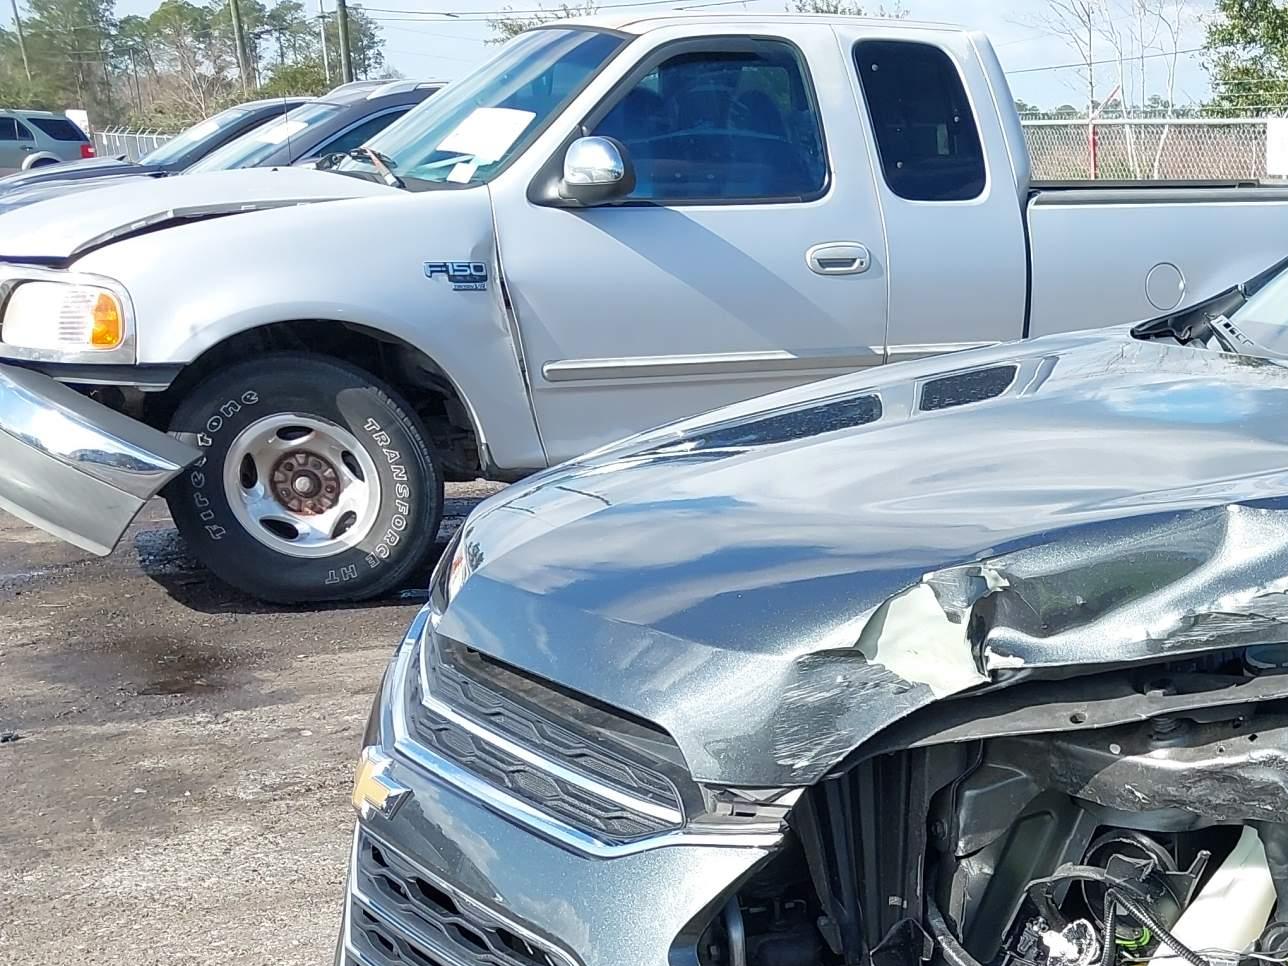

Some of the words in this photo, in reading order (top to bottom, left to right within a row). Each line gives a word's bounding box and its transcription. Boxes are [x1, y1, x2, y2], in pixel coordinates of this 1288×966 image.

[424, 262, 487, 279] F-150
[363, 417, 410, 568] TRANSFORCE
[325, 564, 358, 584] HT
